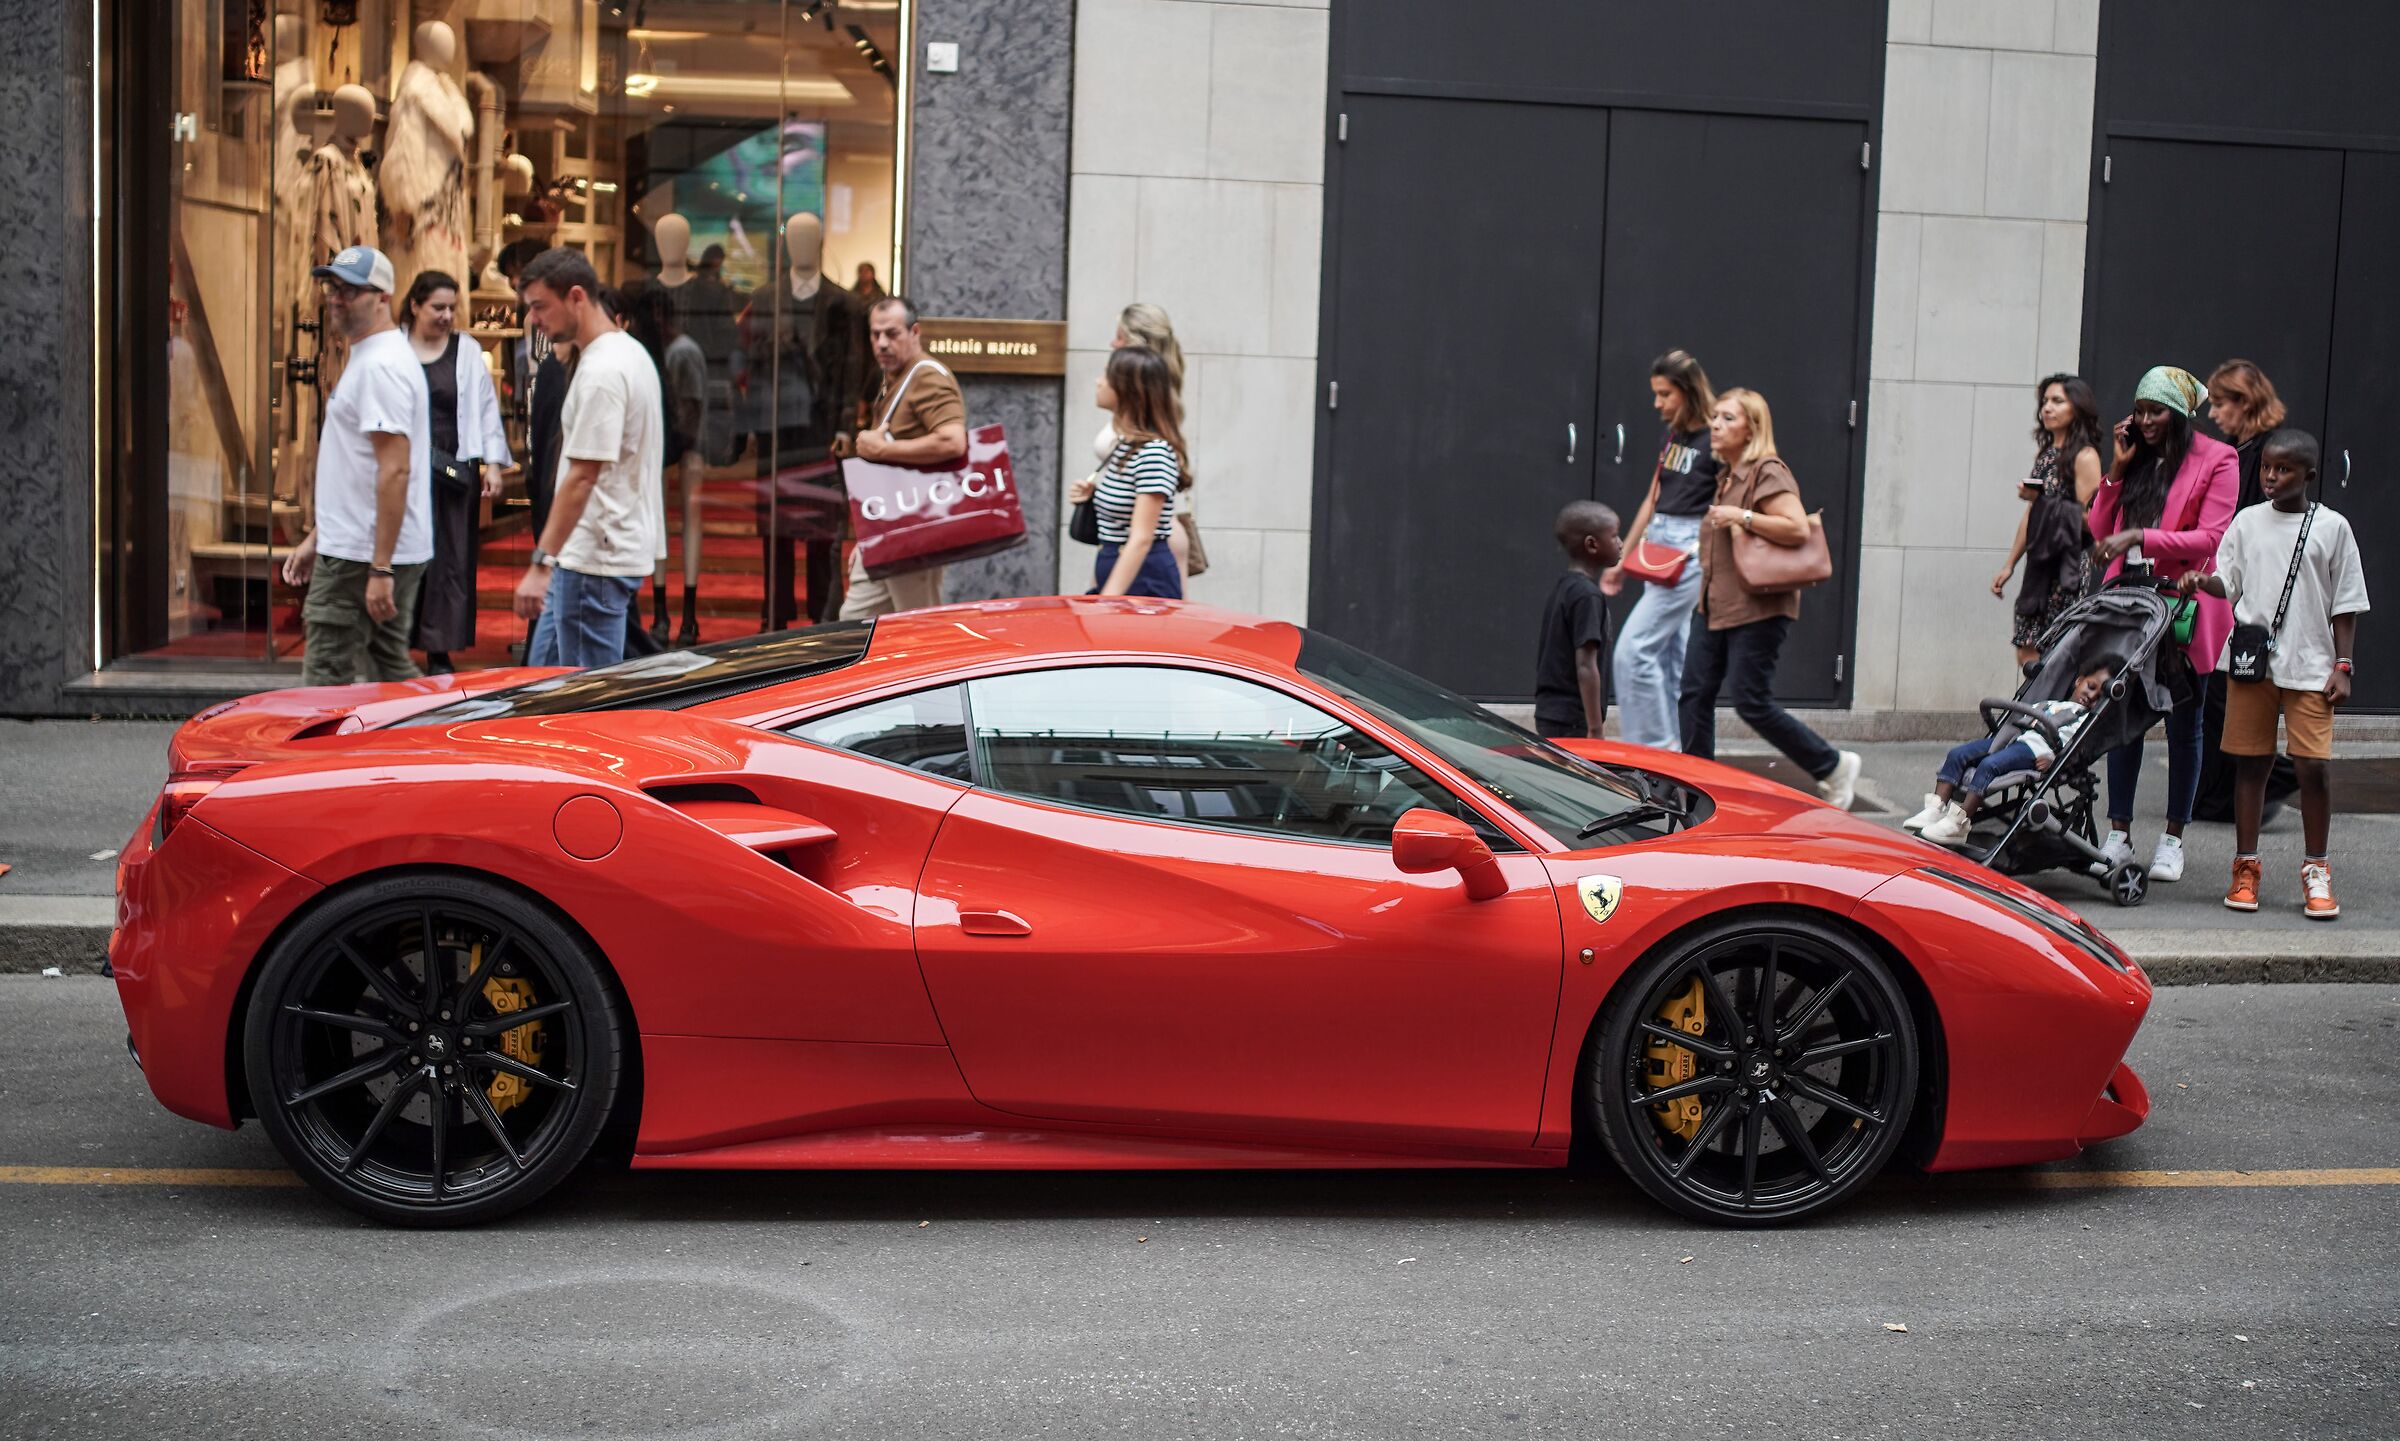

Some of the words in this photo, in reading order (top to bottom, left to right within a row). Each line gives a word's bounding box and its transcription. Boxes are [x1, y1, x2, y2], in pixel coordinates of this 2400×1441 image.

[929, 338, 982, 354] antonio
[987, 342, 1037, 355] marras
[861, 468, 1006, 520] GUCCI
